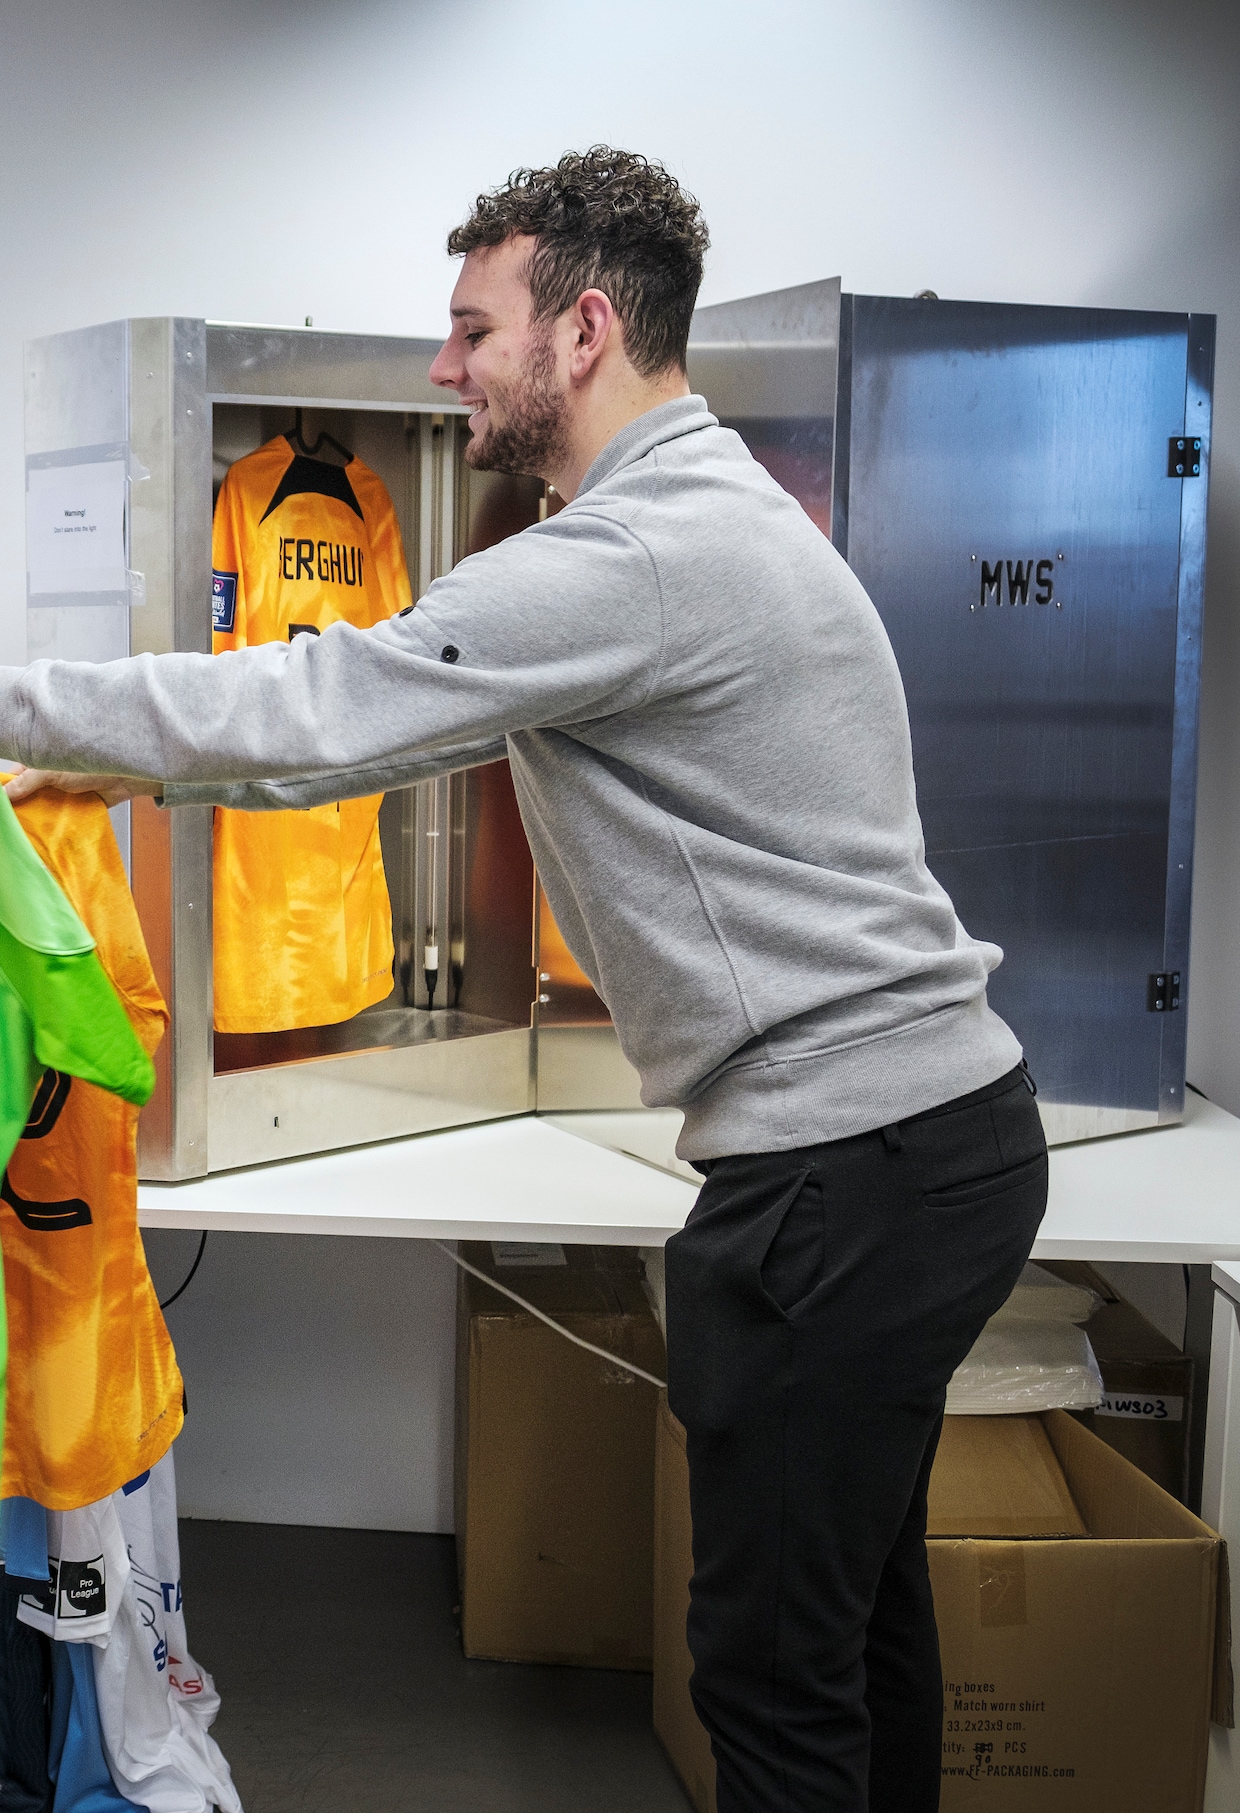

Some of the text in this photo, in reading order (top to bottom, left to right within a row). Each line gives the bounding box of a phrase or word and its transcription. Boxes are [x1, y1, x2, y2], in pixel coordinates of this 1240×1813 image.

[981, 559, 1054, 607] MWS
[79, 1579, 94, 1588] Pro
[70, 1587, 100, 1599] League
[964, 1682, 996, 1693] boxes
[953, 1699, 988, 1712] Match
[990, 1702, 1017, 1712] worn
[1018, 1700, 1046, 1713] shirt
[946, 1720, 1027, 1732] 33.2x23x9 cm.
[1004, 1741, 1028, 1754] PCS
[941, 1764, 1076, 1778] www.FF-PACKAGING.com
